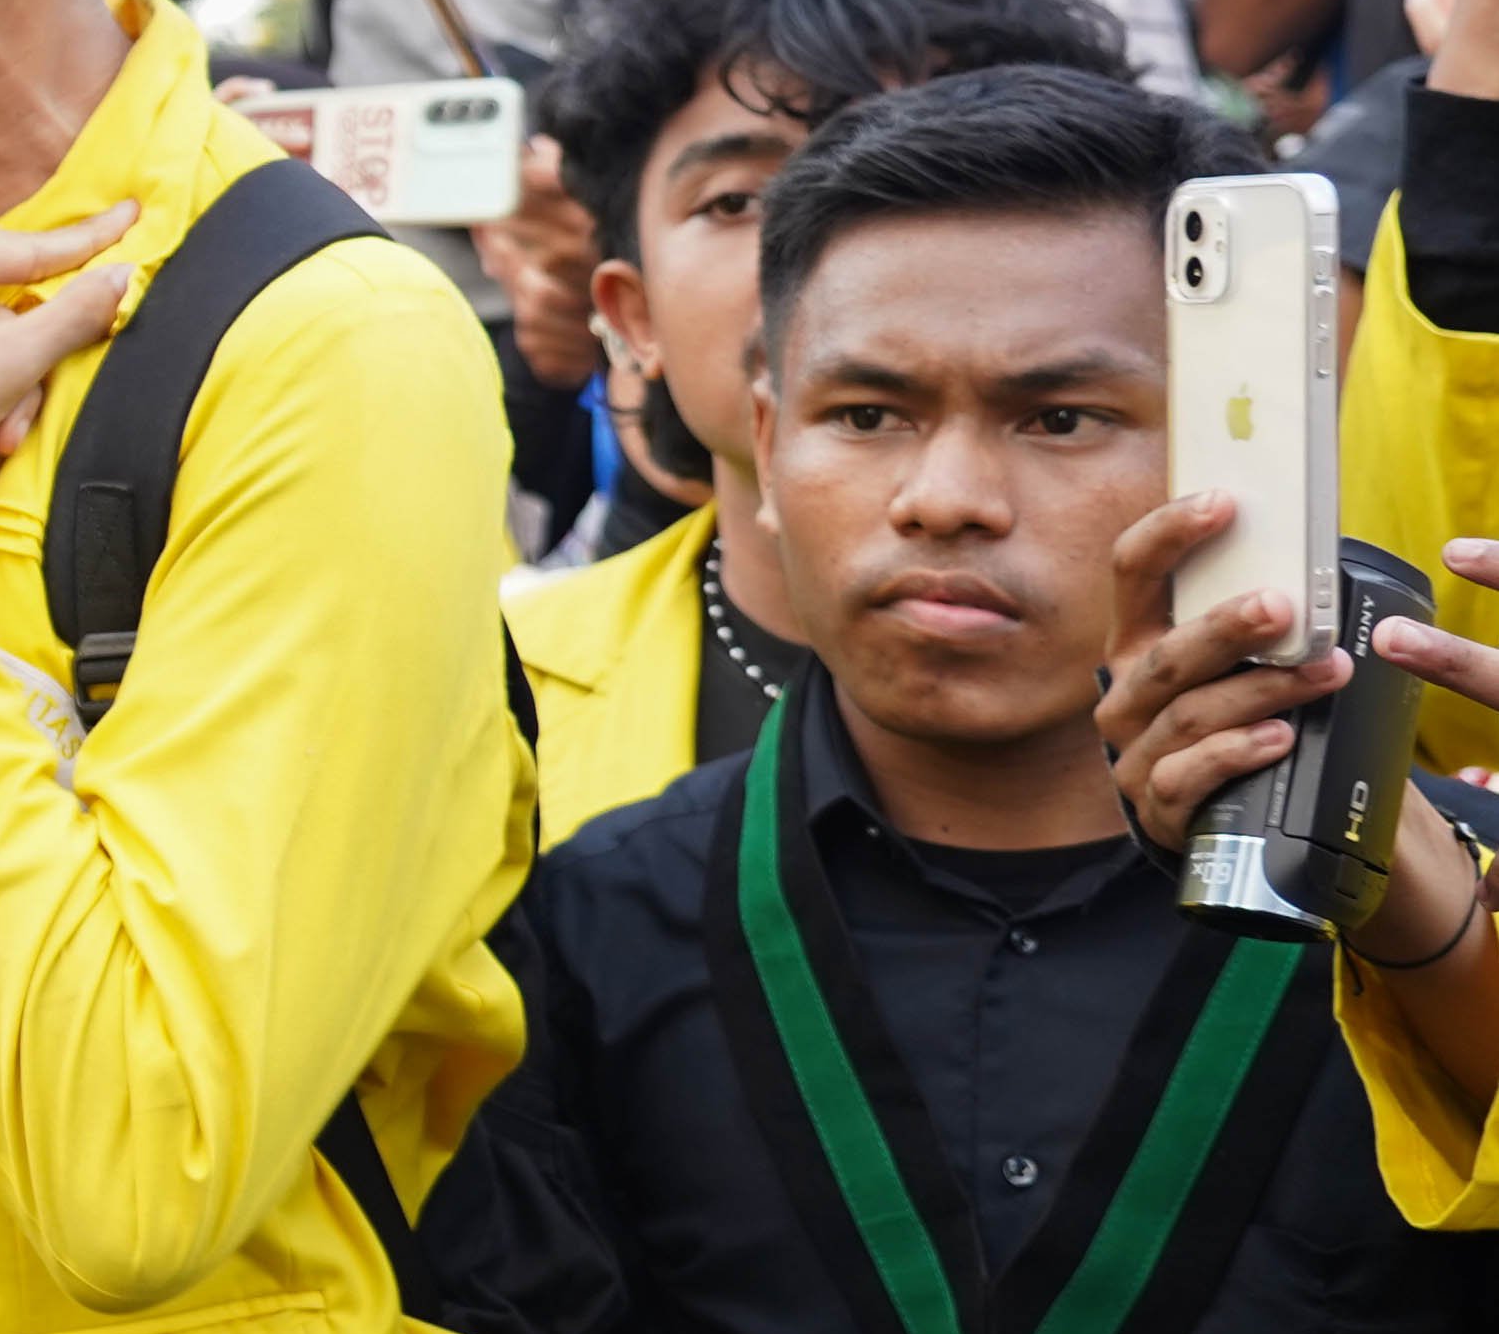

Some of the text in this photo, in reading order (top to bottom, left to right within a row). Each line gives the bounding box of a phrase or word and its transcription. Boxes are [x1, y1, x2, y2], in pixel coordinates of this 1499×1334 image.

[1354, 595, 1377, 659] SONY
[27, 688, 83, 760] ITAS
[1344, 780, 1370, 843] HD
